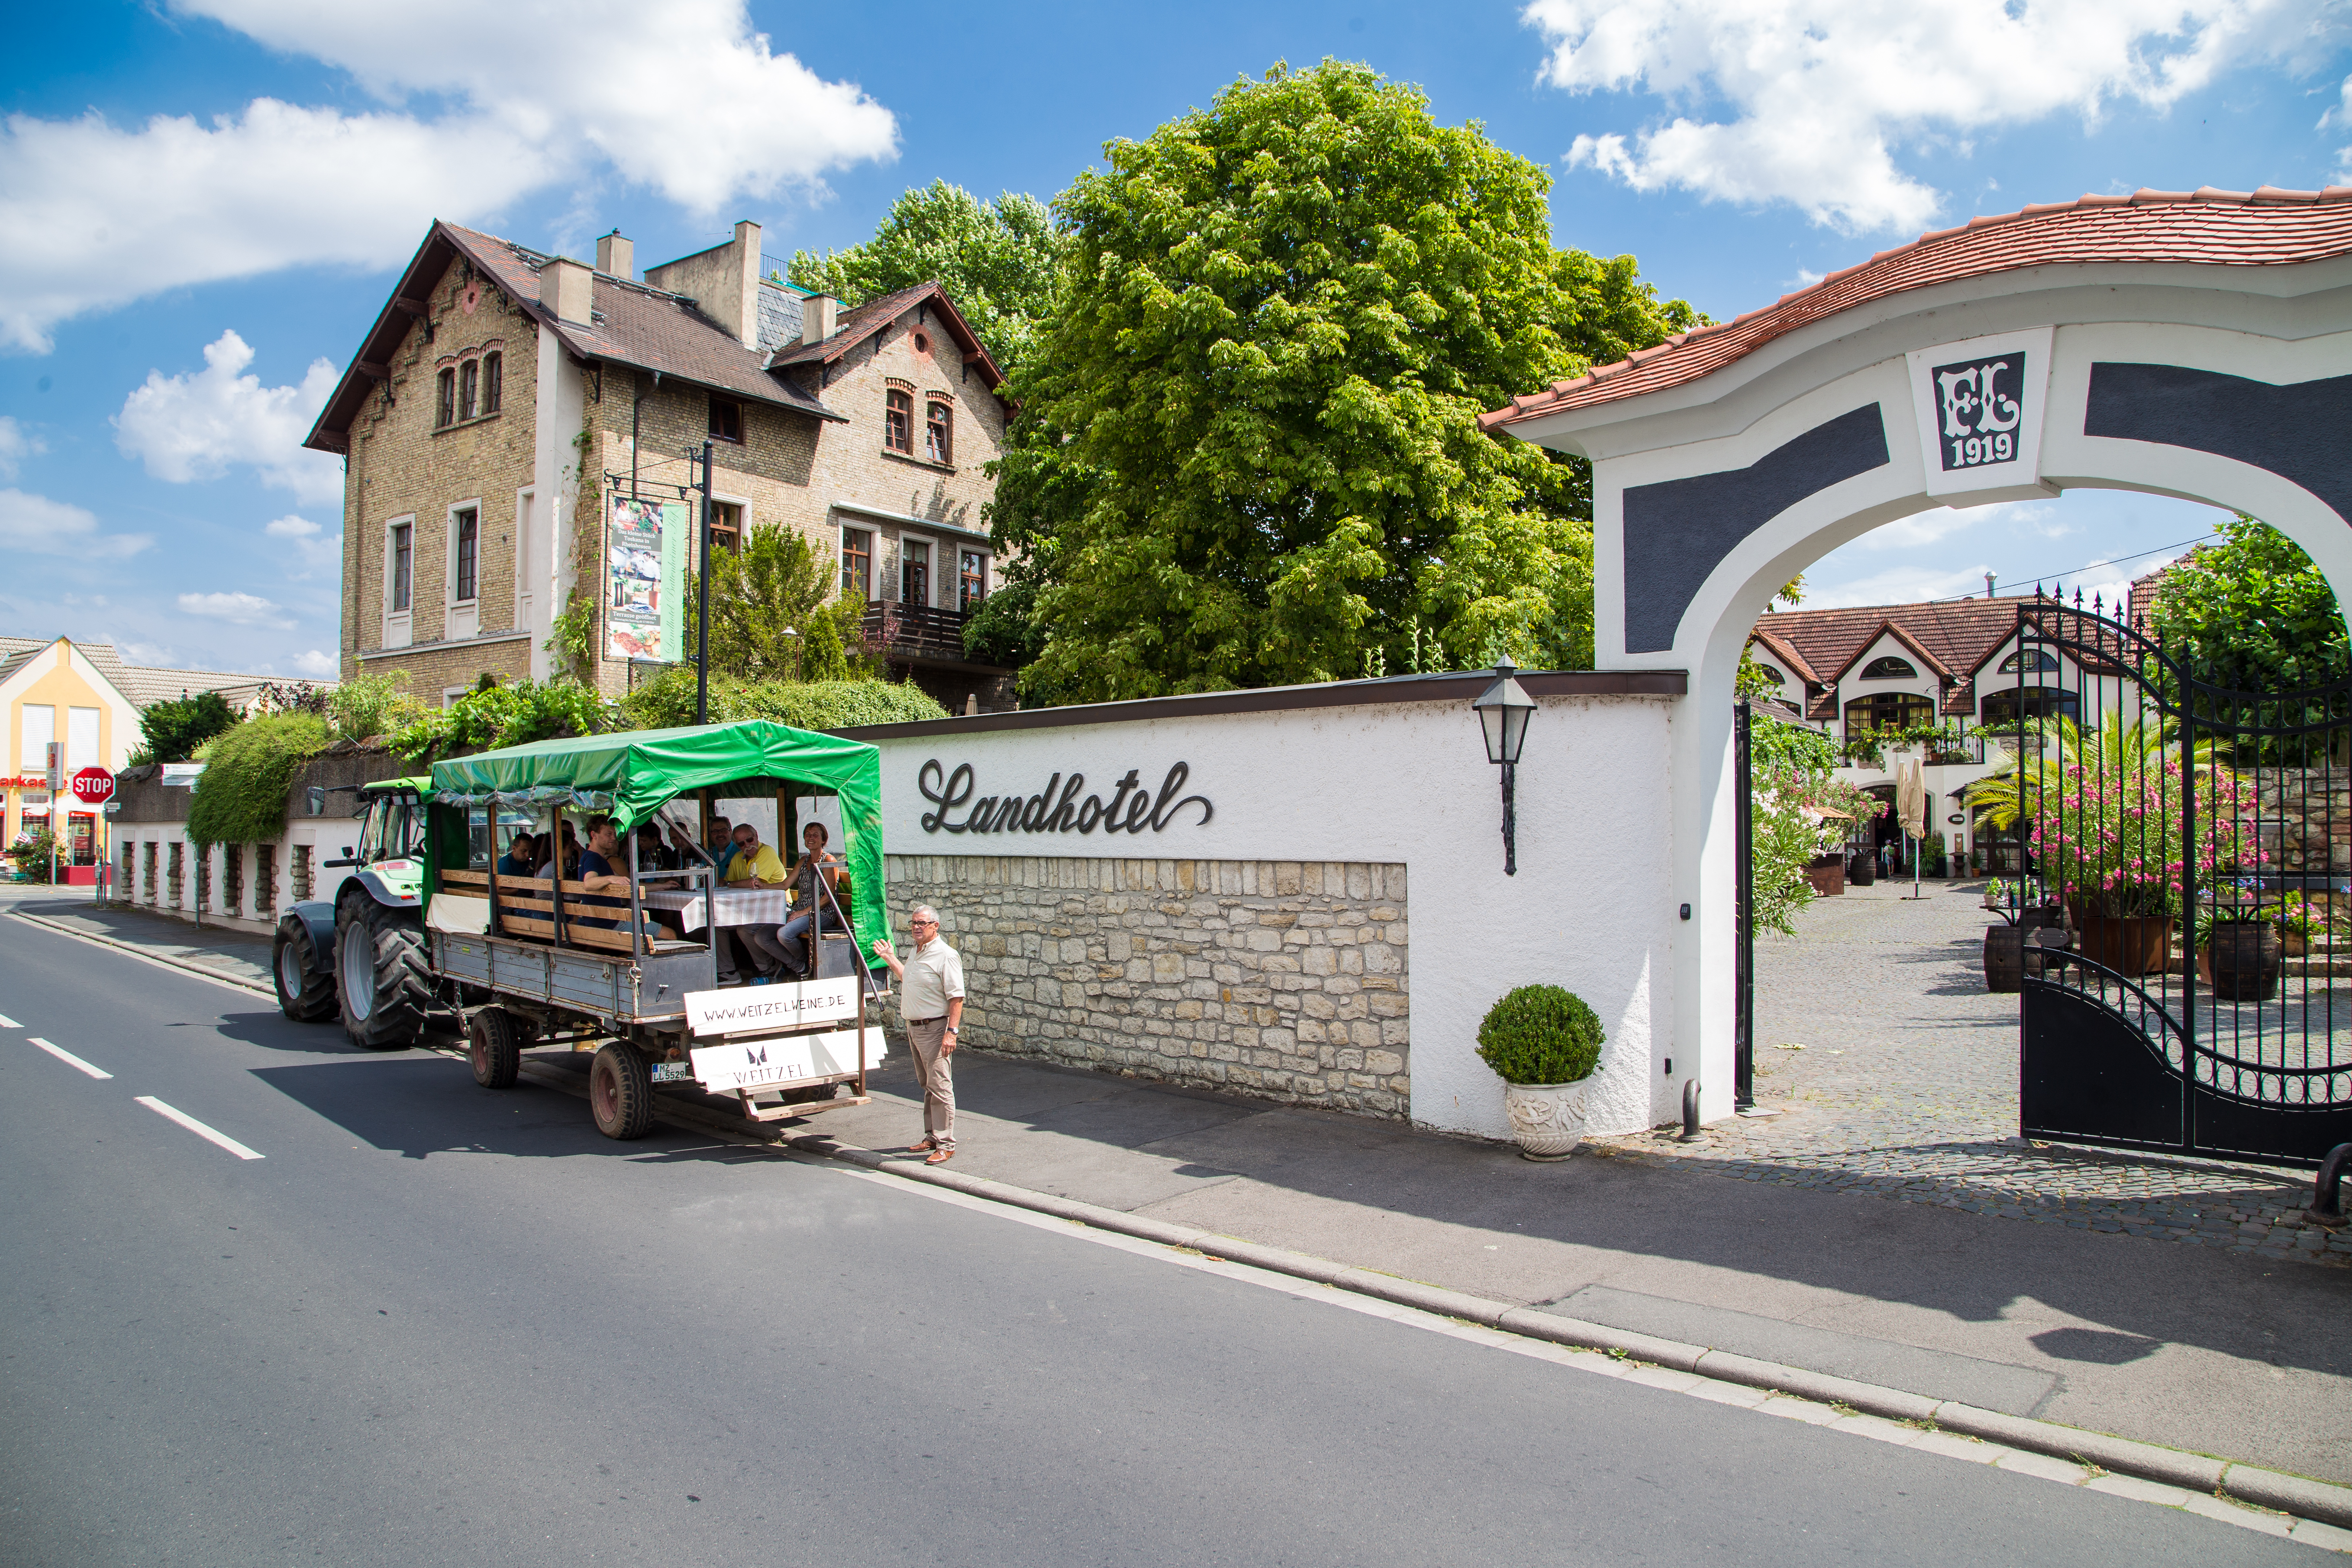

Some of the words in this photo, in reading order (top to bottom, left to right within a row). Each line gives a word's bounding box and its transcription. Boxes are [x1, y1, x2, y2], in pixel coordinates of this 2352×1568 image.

[1951, 433, 2012, 467] 1919
[665, 509, 681, 534] Hof
[622, 541, 652, 550] Rheinhessen
[664, 537, 677, 603] Battenheimer
[663, 606, 675, 655] Landhotel
[75, 778, 111, 793] STOP
[918, 759, 1213, 833] Landhotel
[704, 995, 845, 1021] WWW.WEITZELWEINE.DE
[654, 1073, 664, 1081] LL
[665, 1070, 684, 1080] 5529
[660, 1064, 670, 1072] MZ
[733, 1064, 807, 1084] WEITZEL
